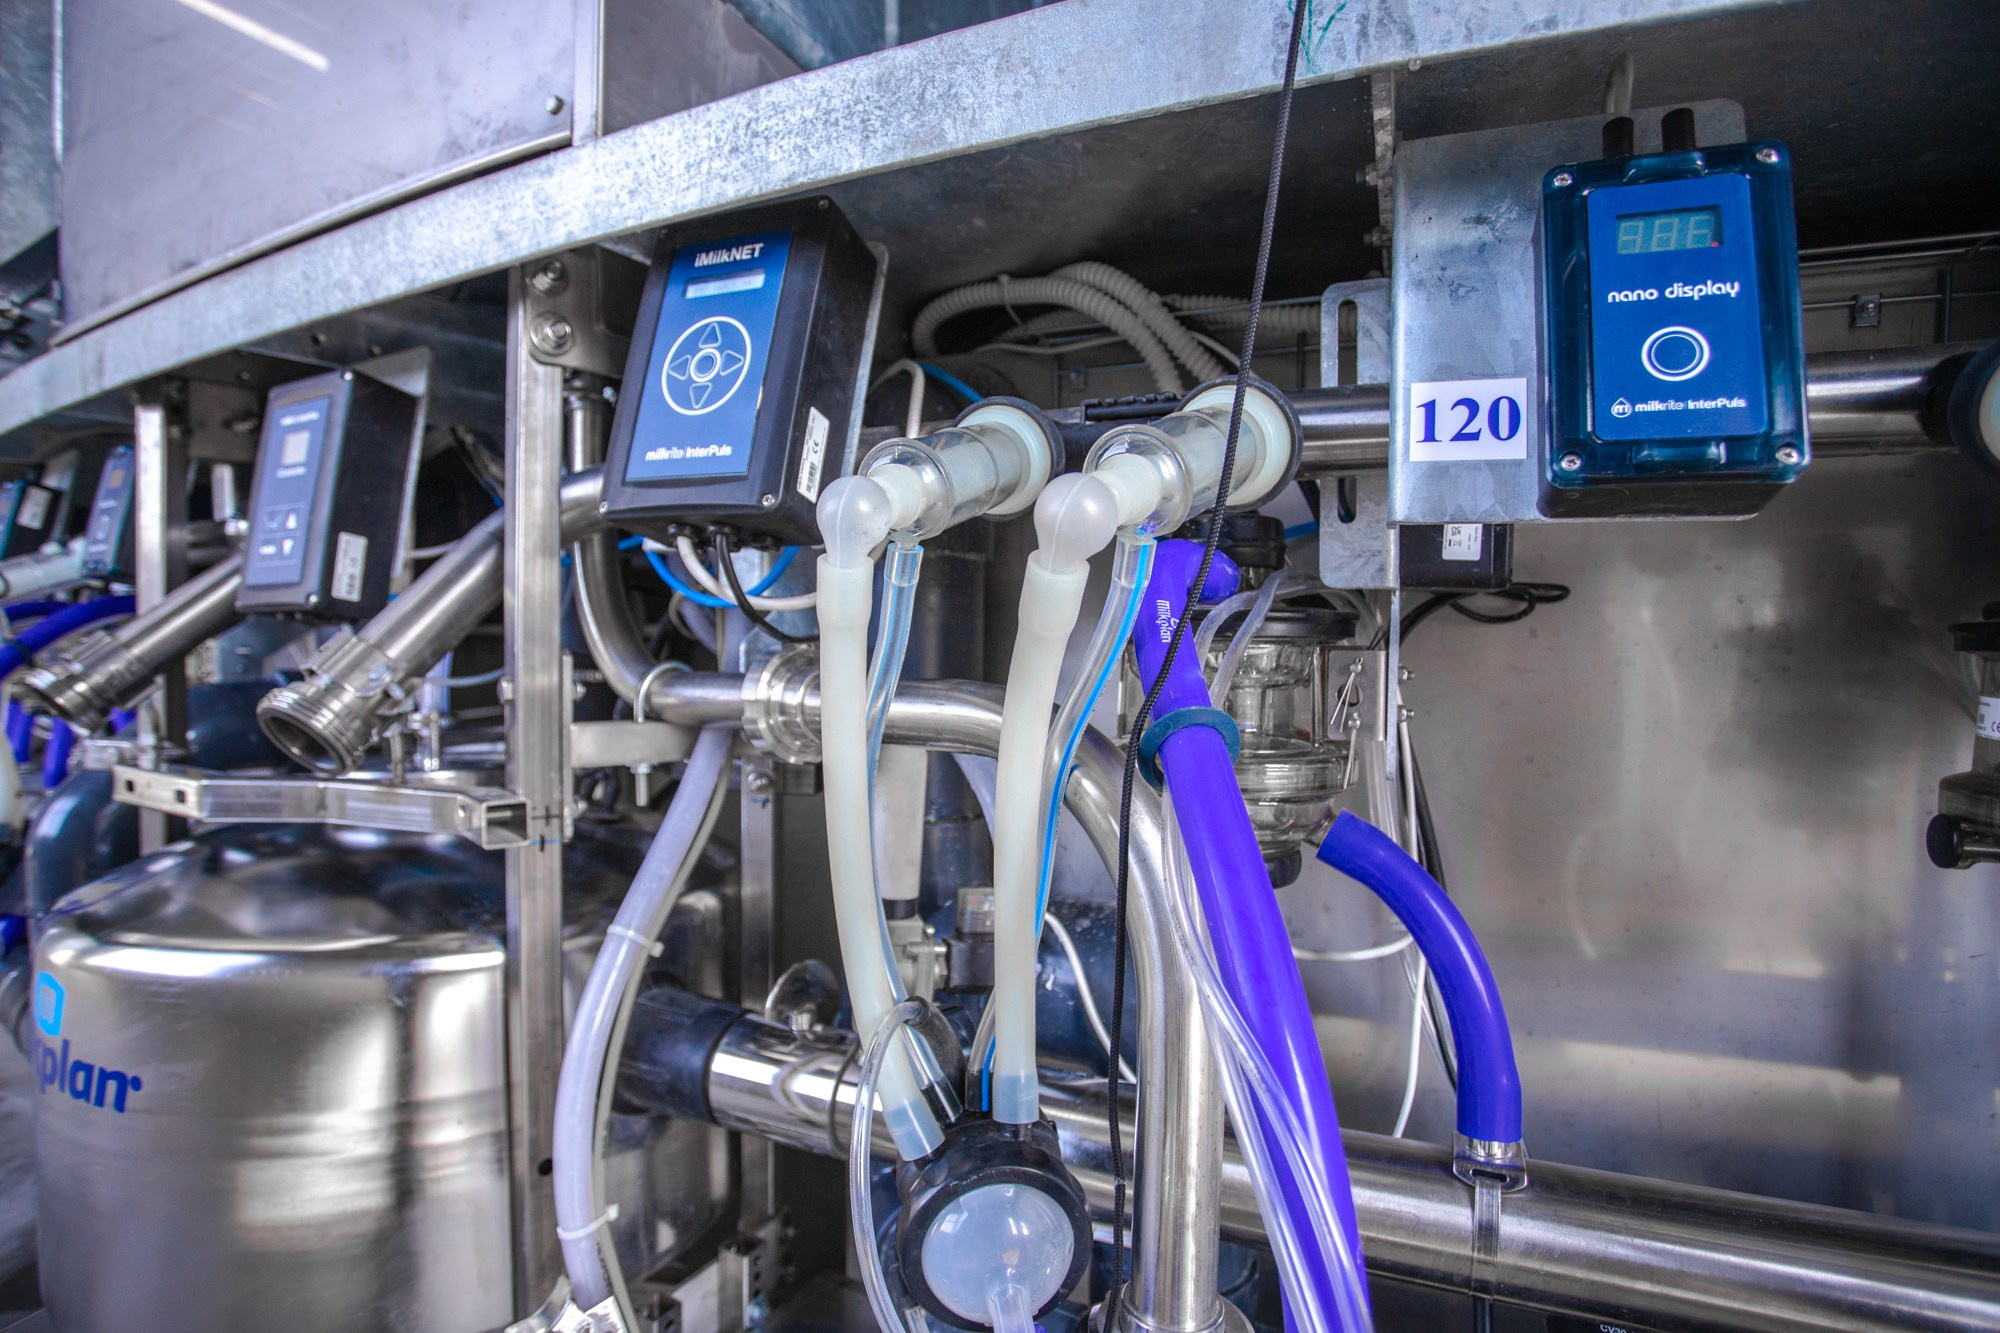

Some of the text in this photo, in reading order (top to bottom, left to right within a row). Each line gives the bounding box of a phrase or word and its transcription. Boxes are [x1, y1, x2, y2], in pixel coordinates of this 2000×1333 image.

[694, 243, 764, 268] iMilkNET
[1608, 280, 1740, 303] nano display
[1634, 397, 1747, 412] milkrite InterPuls
[1416, 396, 1521, 443] 120
[685, 443, 732, 458] InterPuls
